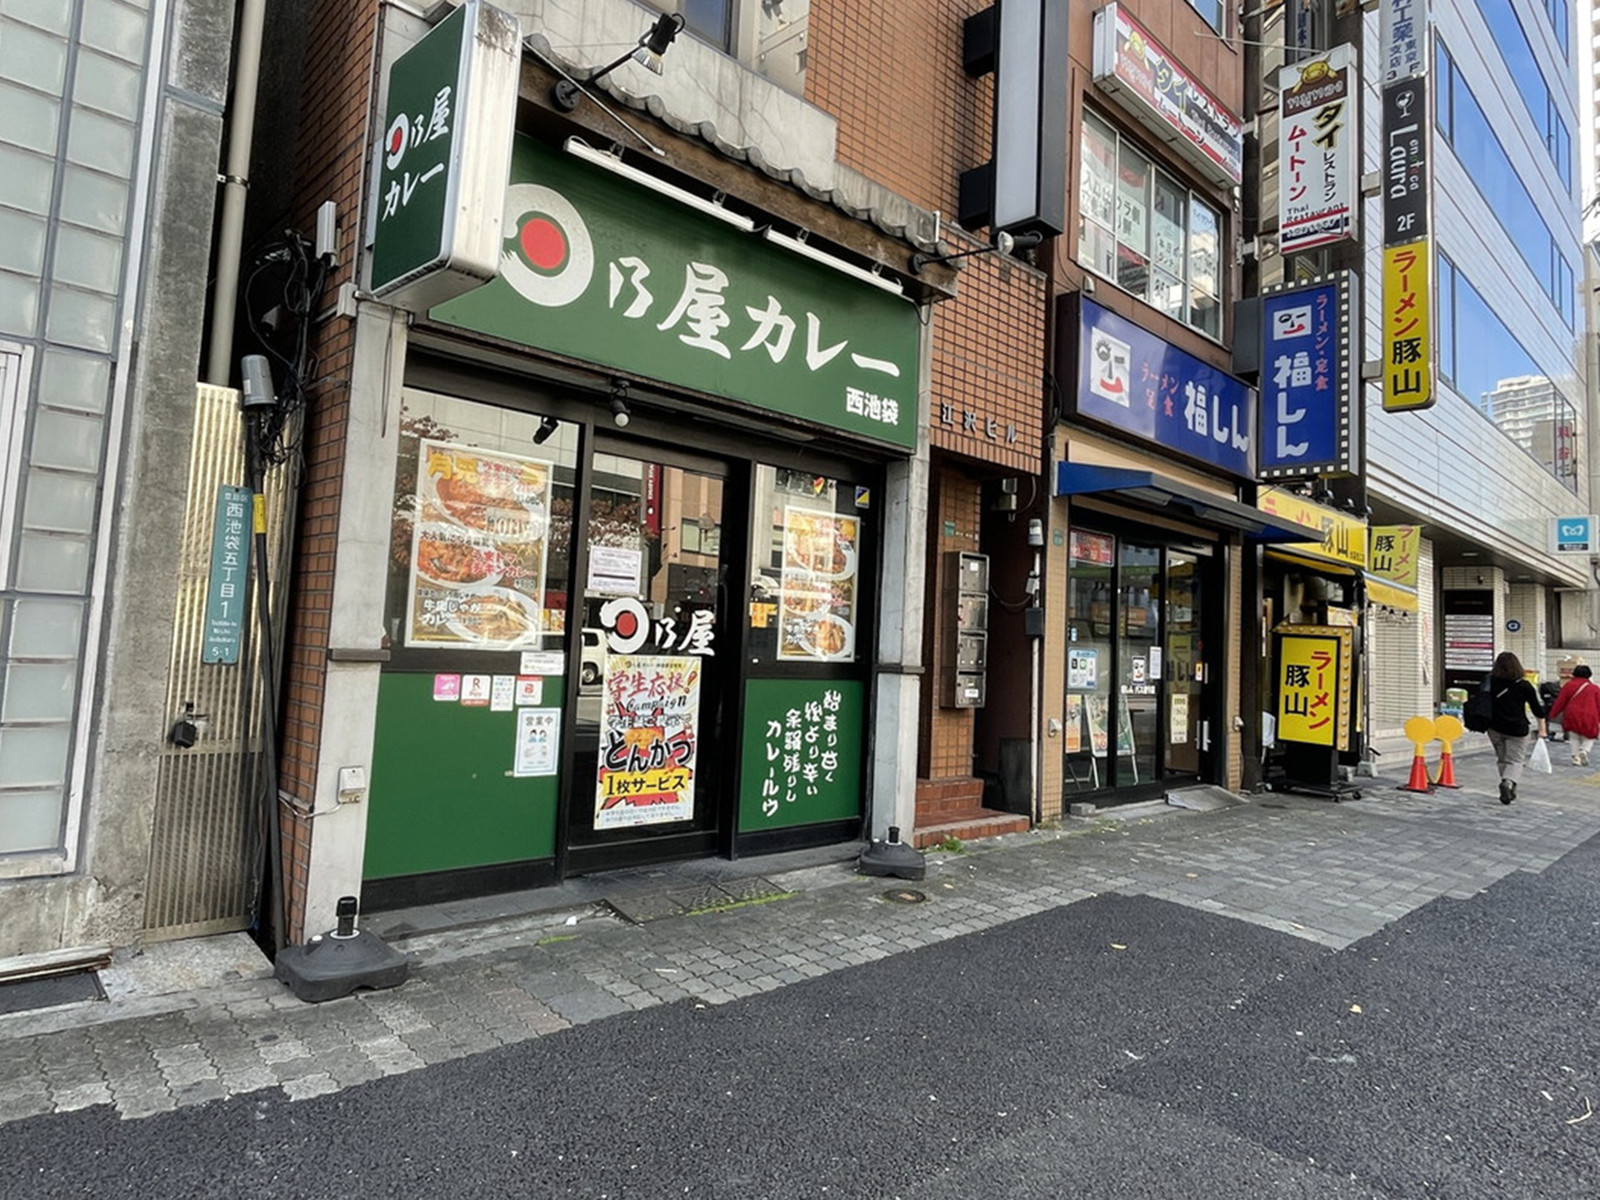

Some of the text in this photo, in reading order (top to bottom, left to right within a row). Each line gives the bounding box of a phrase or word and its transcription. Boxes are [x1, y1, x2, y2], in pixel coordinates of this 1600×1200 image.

[1311, 100, 1346, 150] タイ
[1288, 124, 1308, 203] ムートーン
[1323, 152, 1336, 203] レストラン
[1389, 123, 1419, 200] Laura
[381, 162, 444, 222] カレー
[1396, 212, 1416, 233] 2F
[845, 386, 900, 426] 西池袋
[1183, 380, 1249, 453] 福しん
[1273, 351, 1312, 459] 福しん
[1374, 535, 1396, 573] 豚山
[1394, 526, 1414, 583] ラーメン
[211, 646, 230, 657] 5-1
[1284, 664, 1311, 718] 豚山
[1308, 650, 1332, 730] ラーメン
[602, 732, 694, 774] とんかつ
[821, 690, 842, 783] 始まり甘く
[606, 774, 685, 797] 1枚サービス
[762, 720, 783, 818] カレールウ
